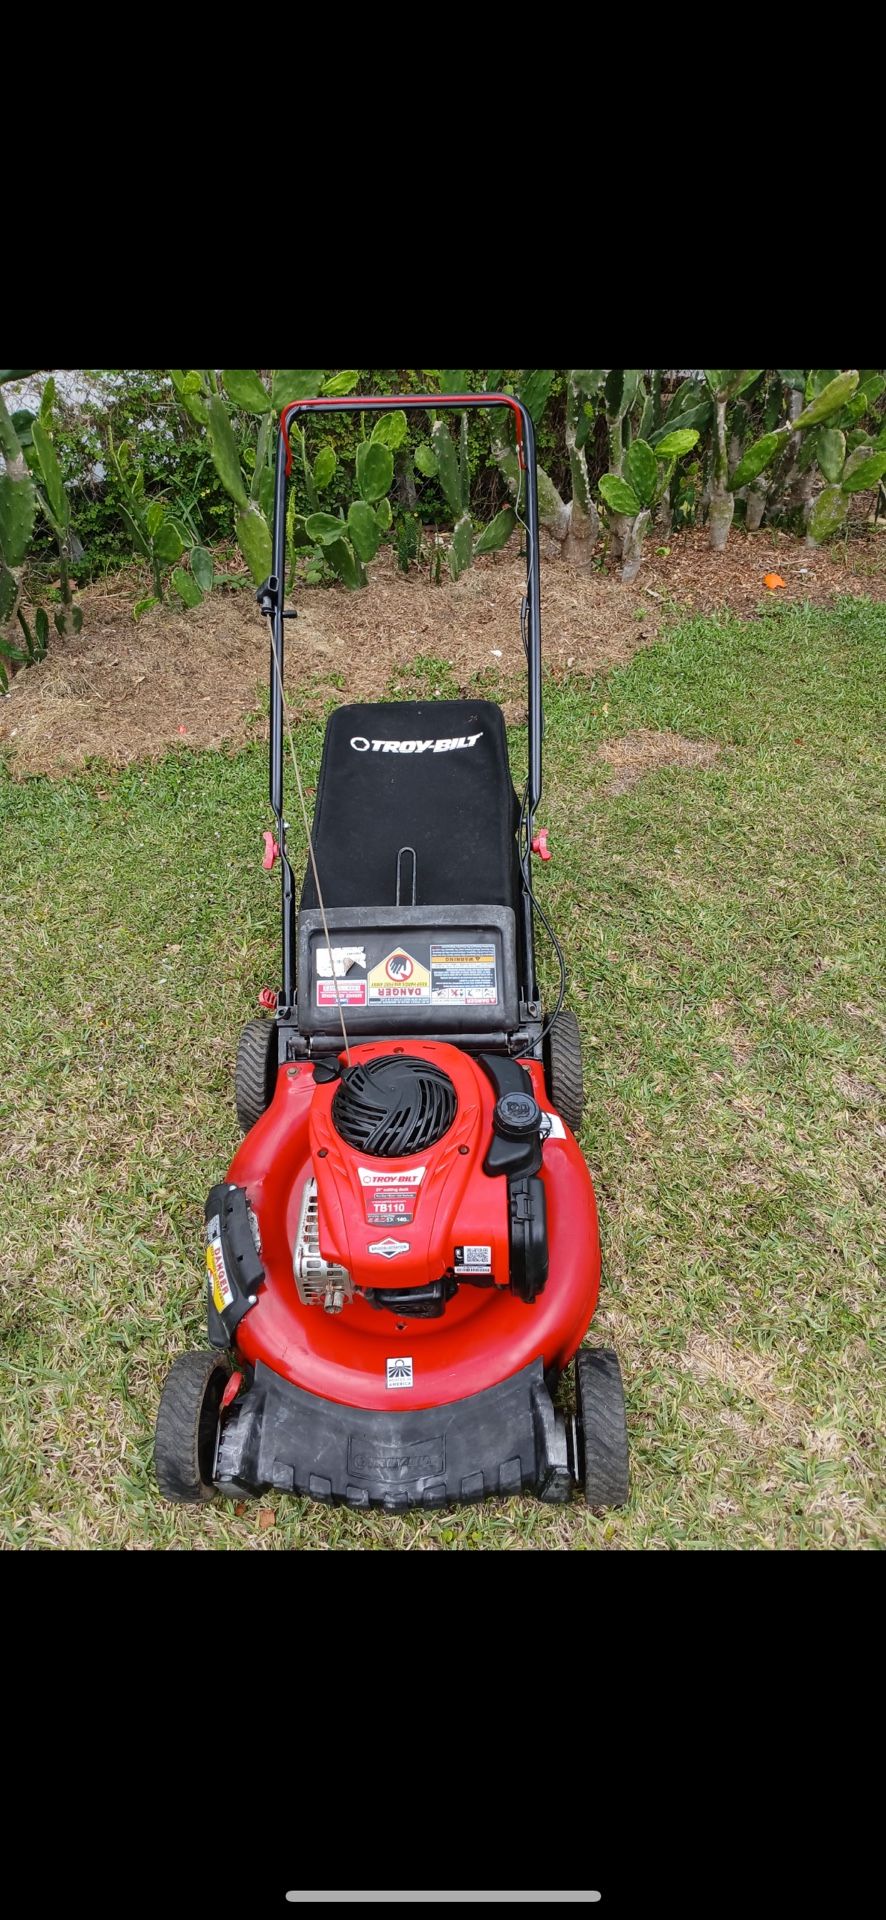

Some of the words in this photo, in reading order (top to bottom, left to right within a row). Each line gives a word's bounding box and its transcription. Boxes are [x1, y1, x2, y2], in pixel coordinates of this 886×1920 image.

[371, 732, 483, 753] TROY-BILT
[378, 988, 421, 996] DANGER
[374, 1204, 404, 1212] TB110
[214, 1247, 229, 1296] DANGER
